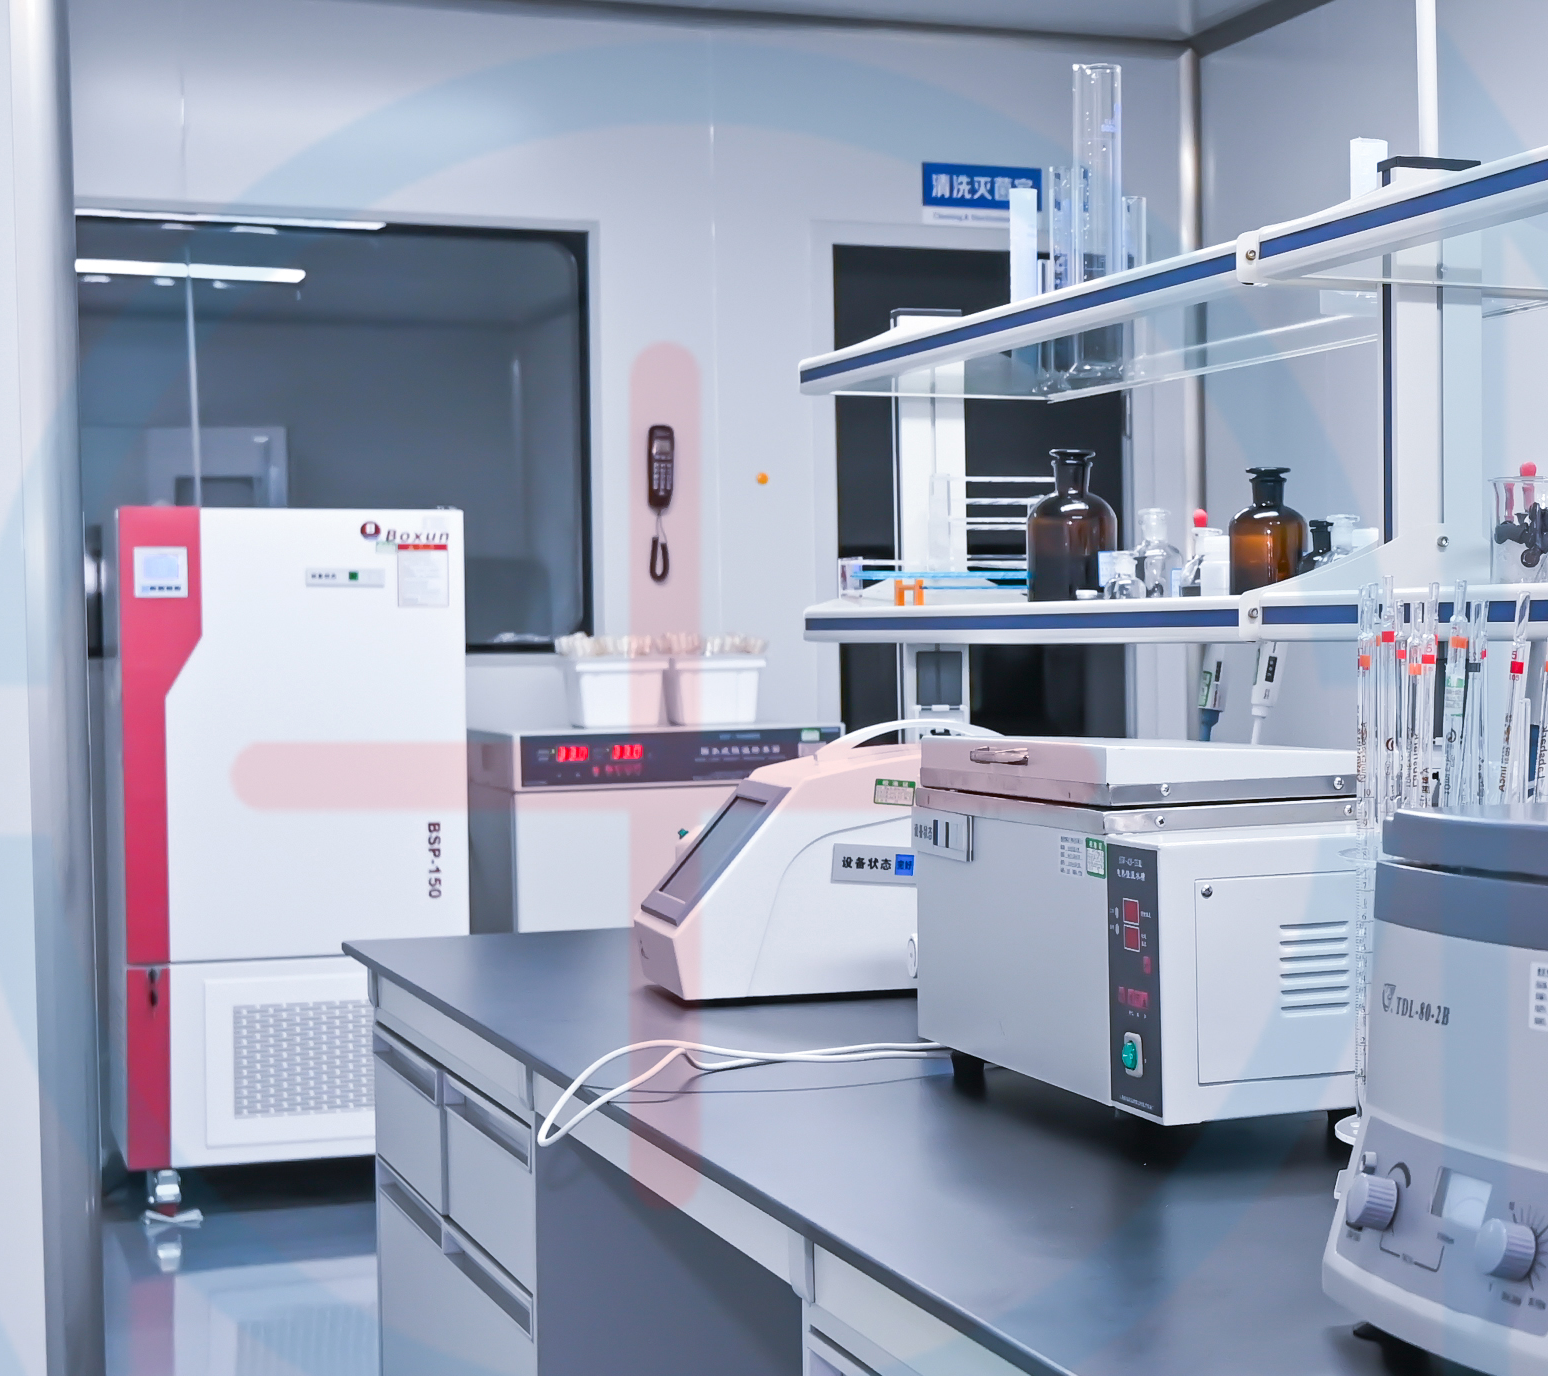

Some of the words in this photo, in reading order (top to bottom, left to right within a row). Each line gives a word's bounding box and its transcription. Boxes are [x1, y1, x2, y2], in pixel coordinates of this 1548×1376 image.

[385, 529, 450, 543] Boxun
[428, 821, 442, 899] BSP-150
[841, 856, 892, 871] 设备状态
